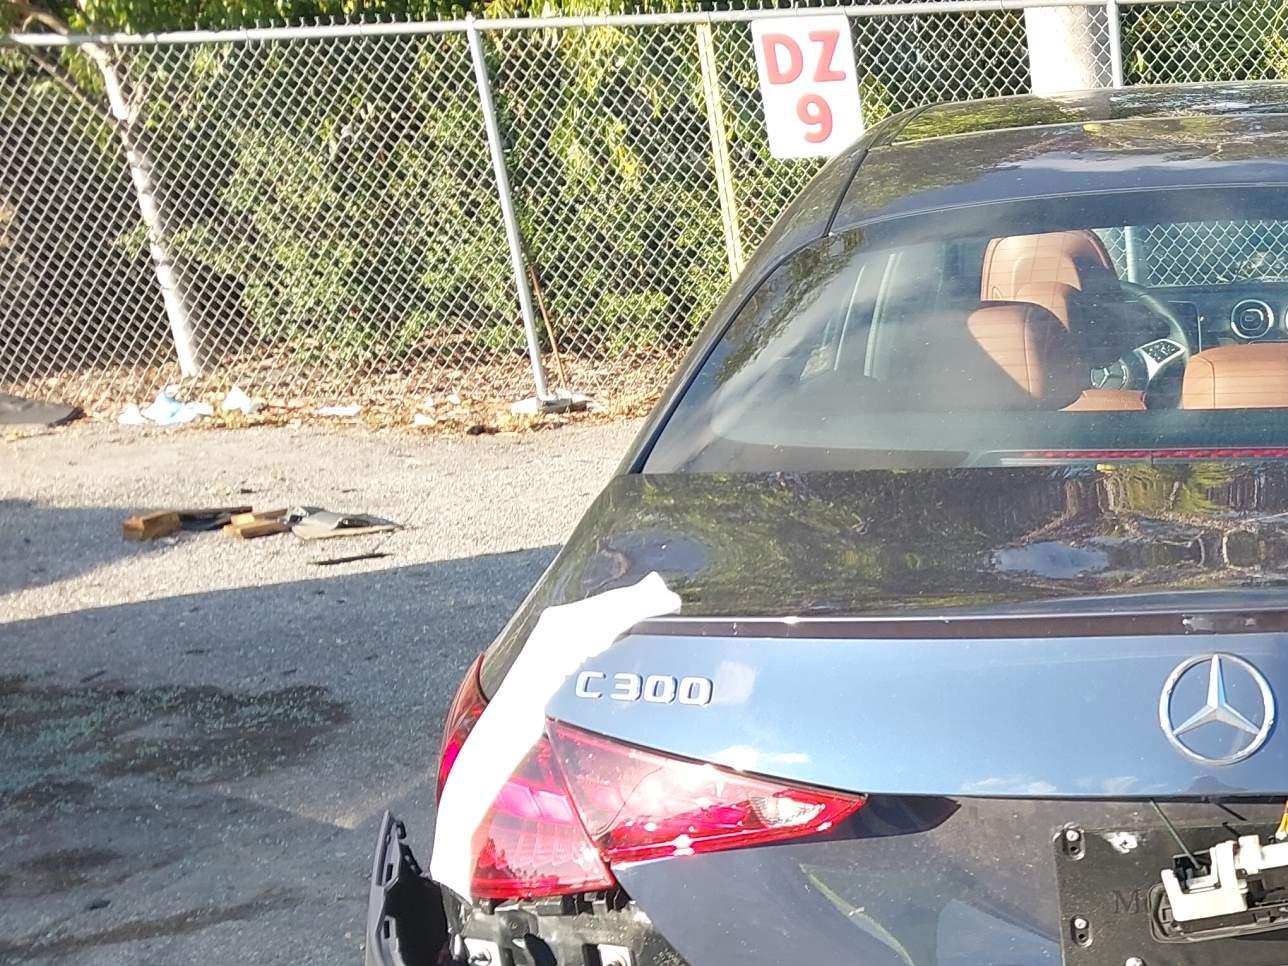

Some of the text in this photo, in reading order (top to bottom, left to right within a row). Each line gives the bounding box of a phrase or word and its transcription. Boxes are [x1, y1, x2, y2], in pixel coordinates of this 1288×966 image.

[761, 30, 847, 85] DZ
[796, 93, 833, 144] 9
[575, 670, 714, 707] C 300
